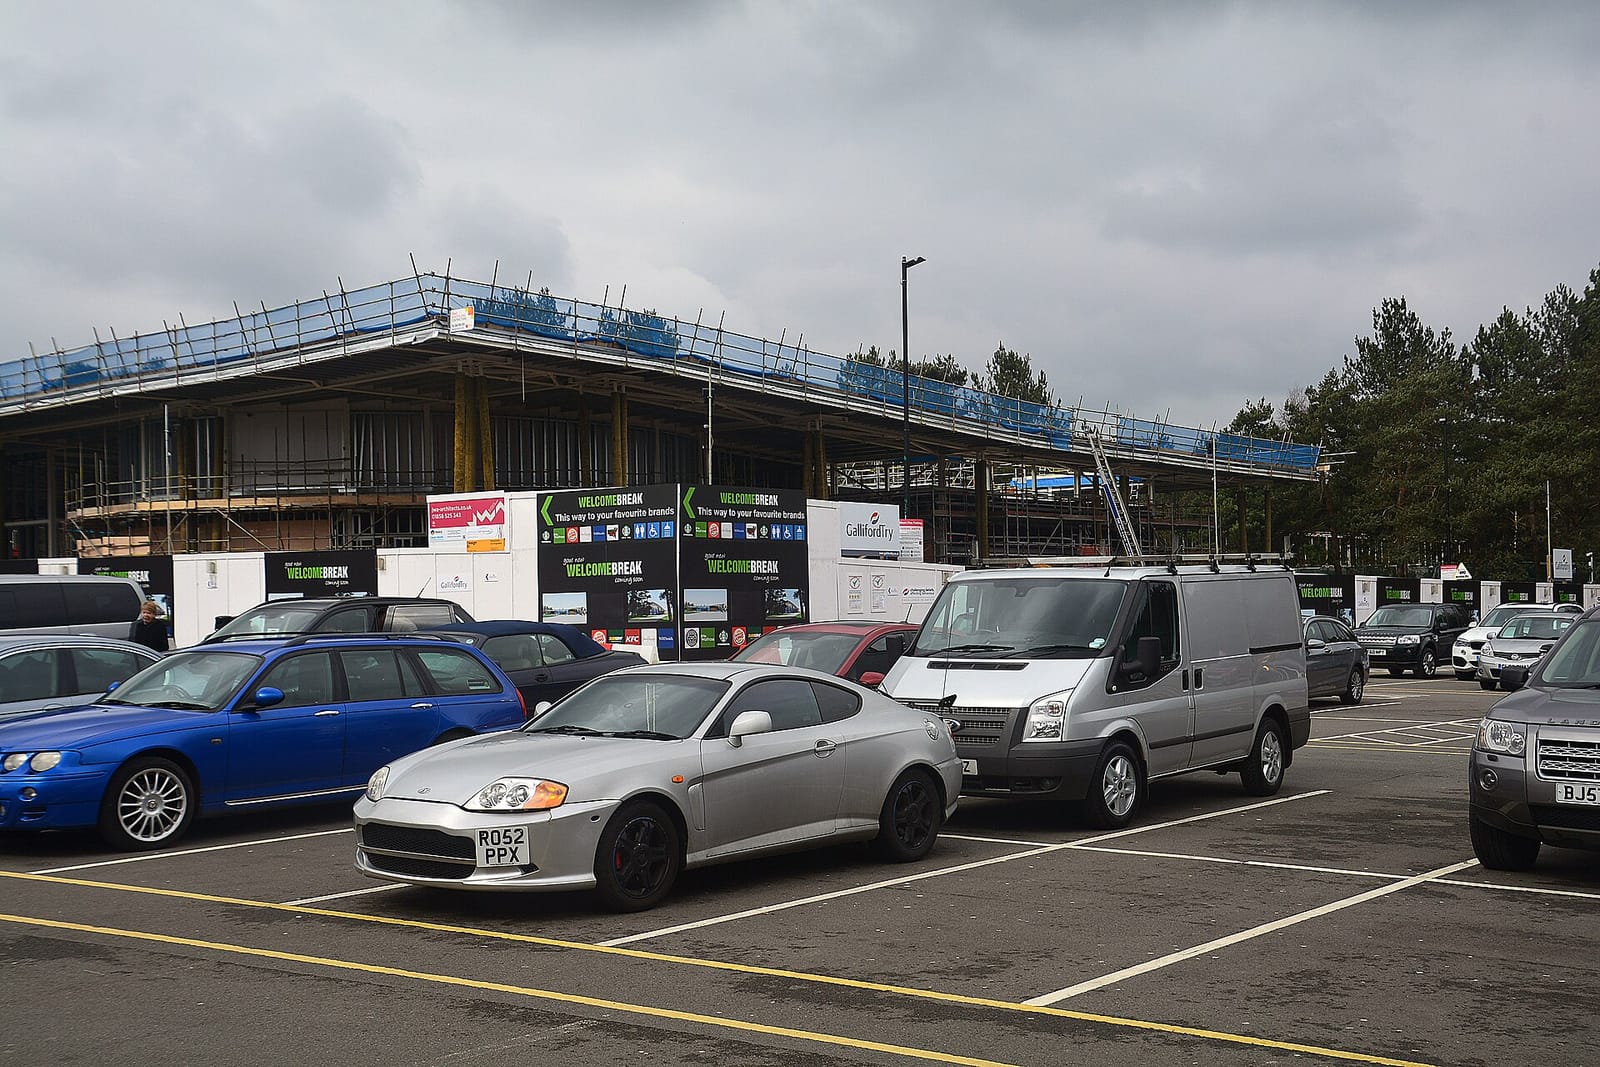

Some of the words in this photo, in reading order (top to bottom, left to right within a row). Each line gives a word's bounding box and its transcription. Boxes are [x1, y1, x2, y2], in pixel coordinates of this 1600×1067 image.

[578, 492, 643, 508] WELCOMEBREAK
[720, 492, 779, 506] WELCOMEBREAK
[555, 513, 571, 522] This
[571, 513, 587, 522] way
[587, 512, 595, 520] to
[596, 512, 613, 521] your
[614, 508, 647, 518] favourite
[648, 506, 675, 516] brands
[697, 506, 712, 516] This
[713, 508, 728, 518] way
[728, 508, 736, 517] to
[736, 509, 752, 519] your
[753, 509, 782, 519] favourite
[783, 510, 805, 519] brands
[846, 523, 894, 541] GallifordTry
[287, 566, 348, 579] WELCOMEBREAK
[566, 561, 643, 577] WELCOMEBREAK
[707, 559, 779, 574] WELCOMEBREAK
[625, 635, 640, 643] KFC
[1564, 785, 1600, 802] BJ5
[479, 829, 525, 847] RO52
[485, 847, 520, 864] PPX
